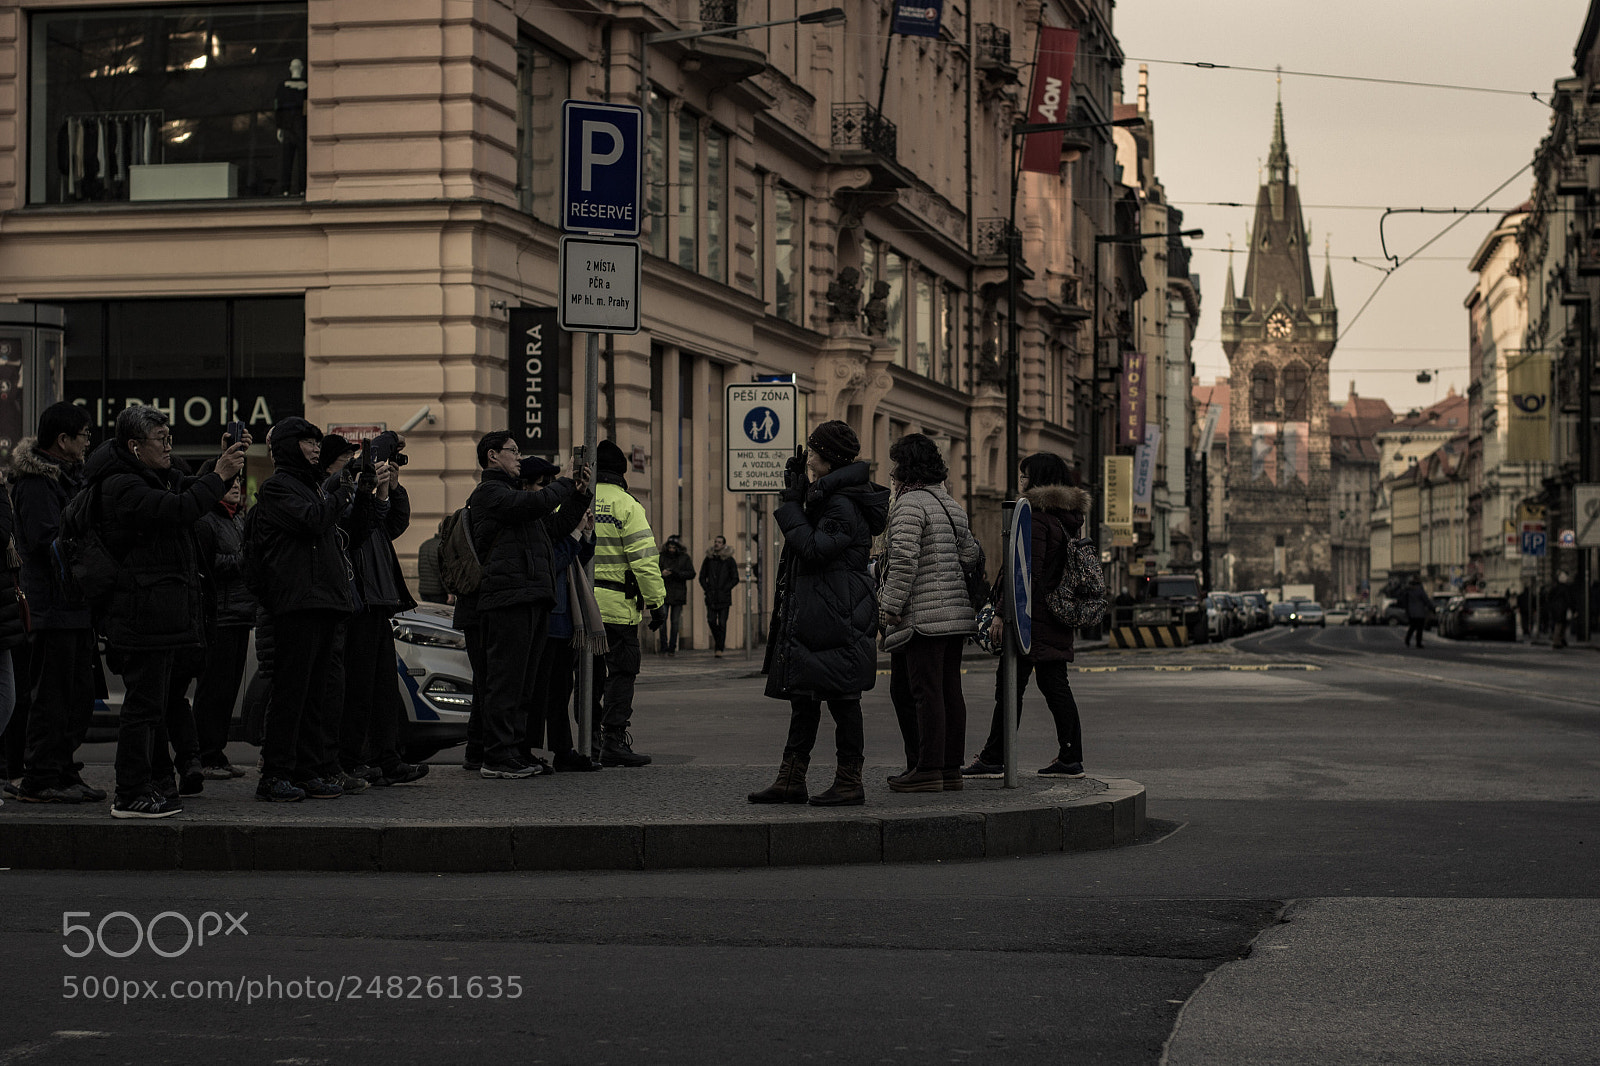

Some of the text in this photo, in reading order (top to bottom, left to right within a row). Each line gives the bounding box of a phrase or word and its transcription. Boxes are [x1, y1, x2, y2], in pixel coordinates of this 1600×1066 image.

[1038, 76, 1062, 123] AON
[581, 119, 625, 192] P
[571, 199, 633, 221] RÉSERVÉ
[586, 258, 616, 273] 2 MÍSTA
[589, 275, 611, 289] PČR a
[571, 293, 630, 310] MP hl. m. Prahy
[526, 323, 542, 439] SEPHORA
[733, 390, 790, 402] PĚŠÍ ZÓNA
[1128, 357, 1140, 441] HOSTEL
[72, 396, 273, 428] EHORA
[751, 461, 781, 469] VOZIDLA
[746, 470, 784, 478] SOUHLASE
[739, 480, 751, 488] MČ
[752, 480, 779, 488] PRAHA
